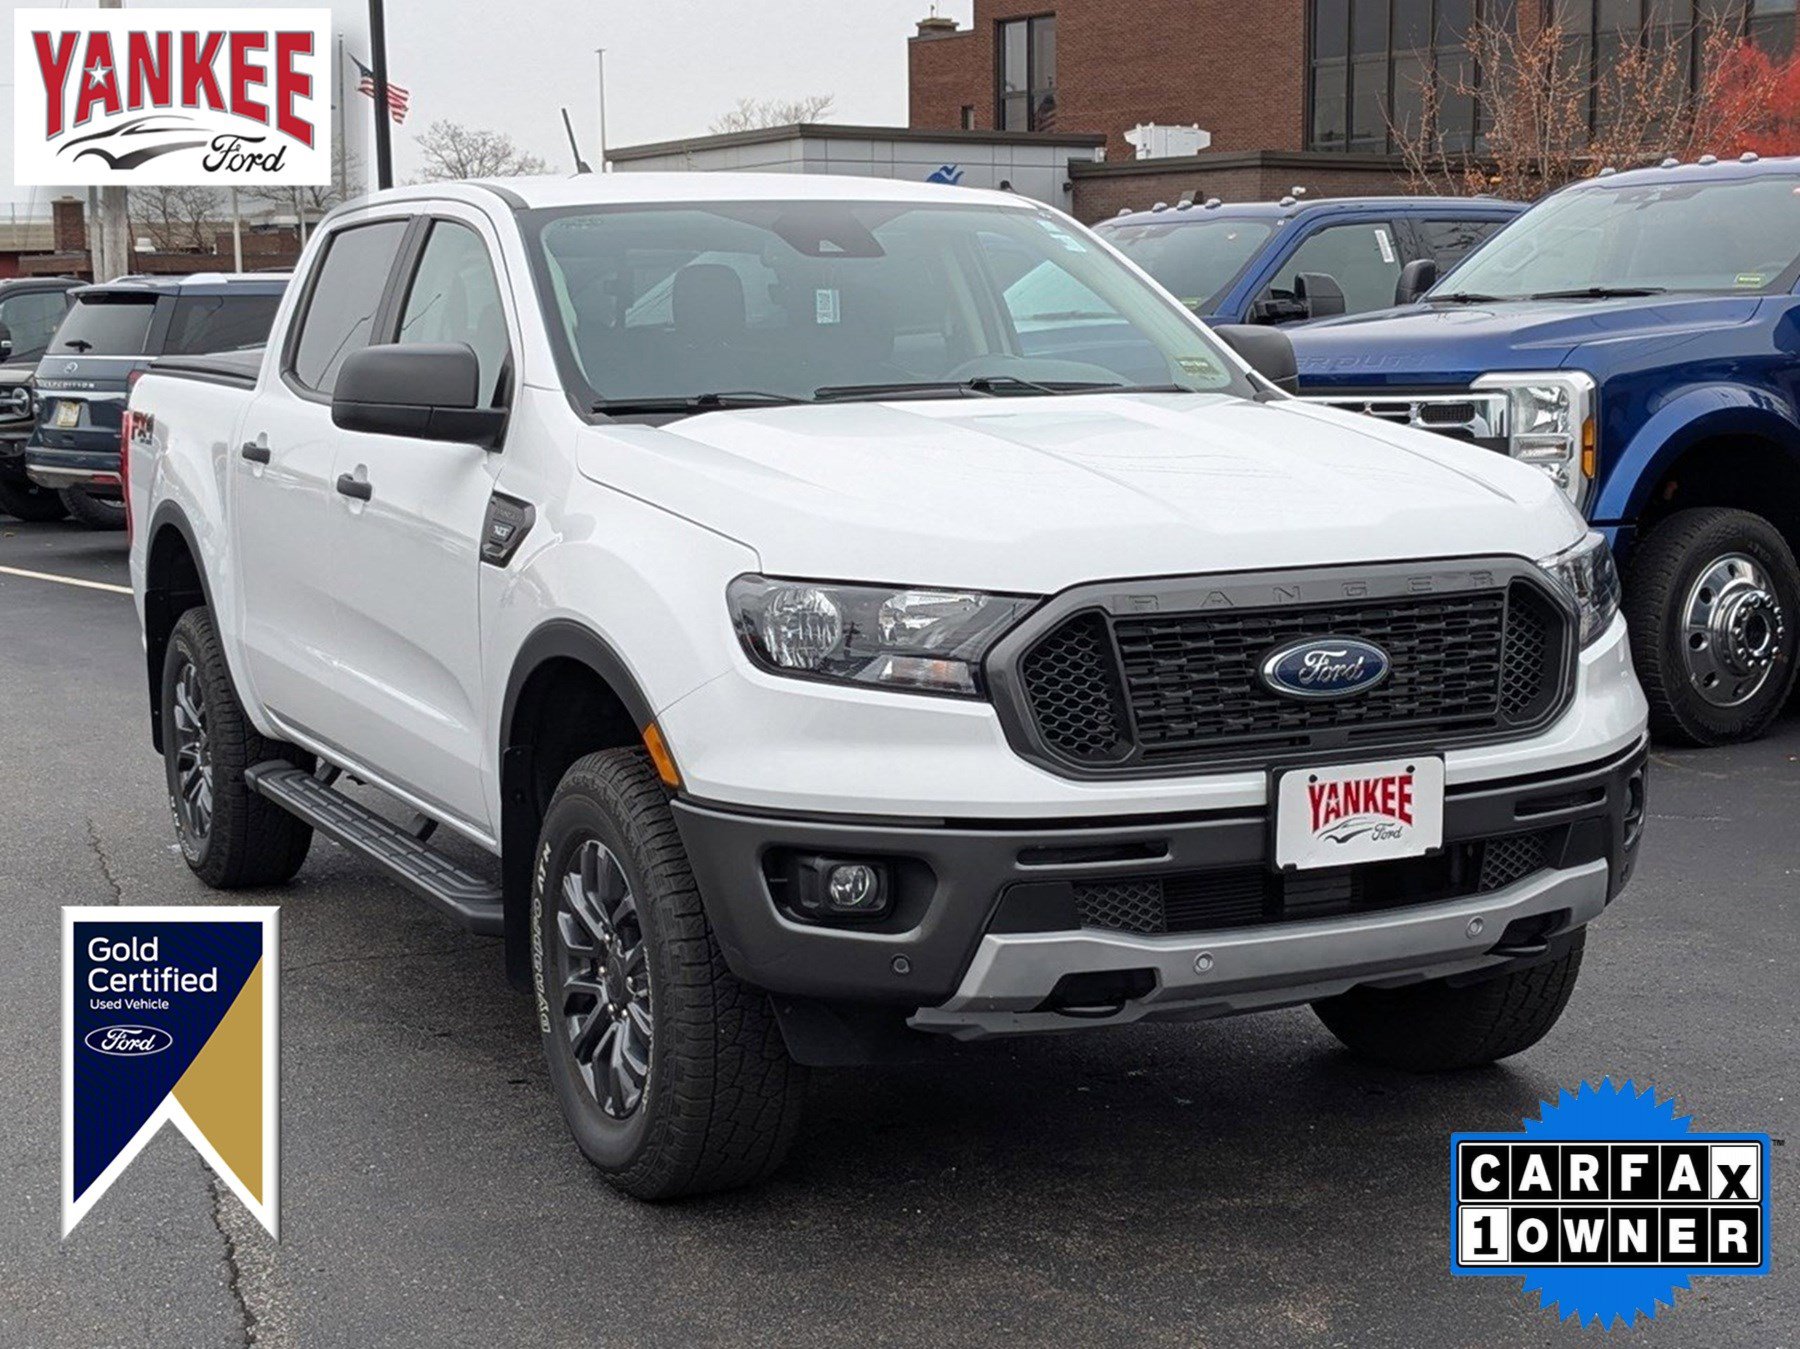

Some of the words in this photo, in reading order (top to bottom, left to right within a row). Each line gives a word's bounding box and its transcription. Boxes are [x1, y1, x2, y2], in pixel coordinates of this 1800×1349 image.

[1127, 569, 1495, 611] RANGER
[1298, 650, 1364, 684] Ford
[1308, 774, 1413, 834] YANKEE
[1371, 823, 1403, 841] Ford
